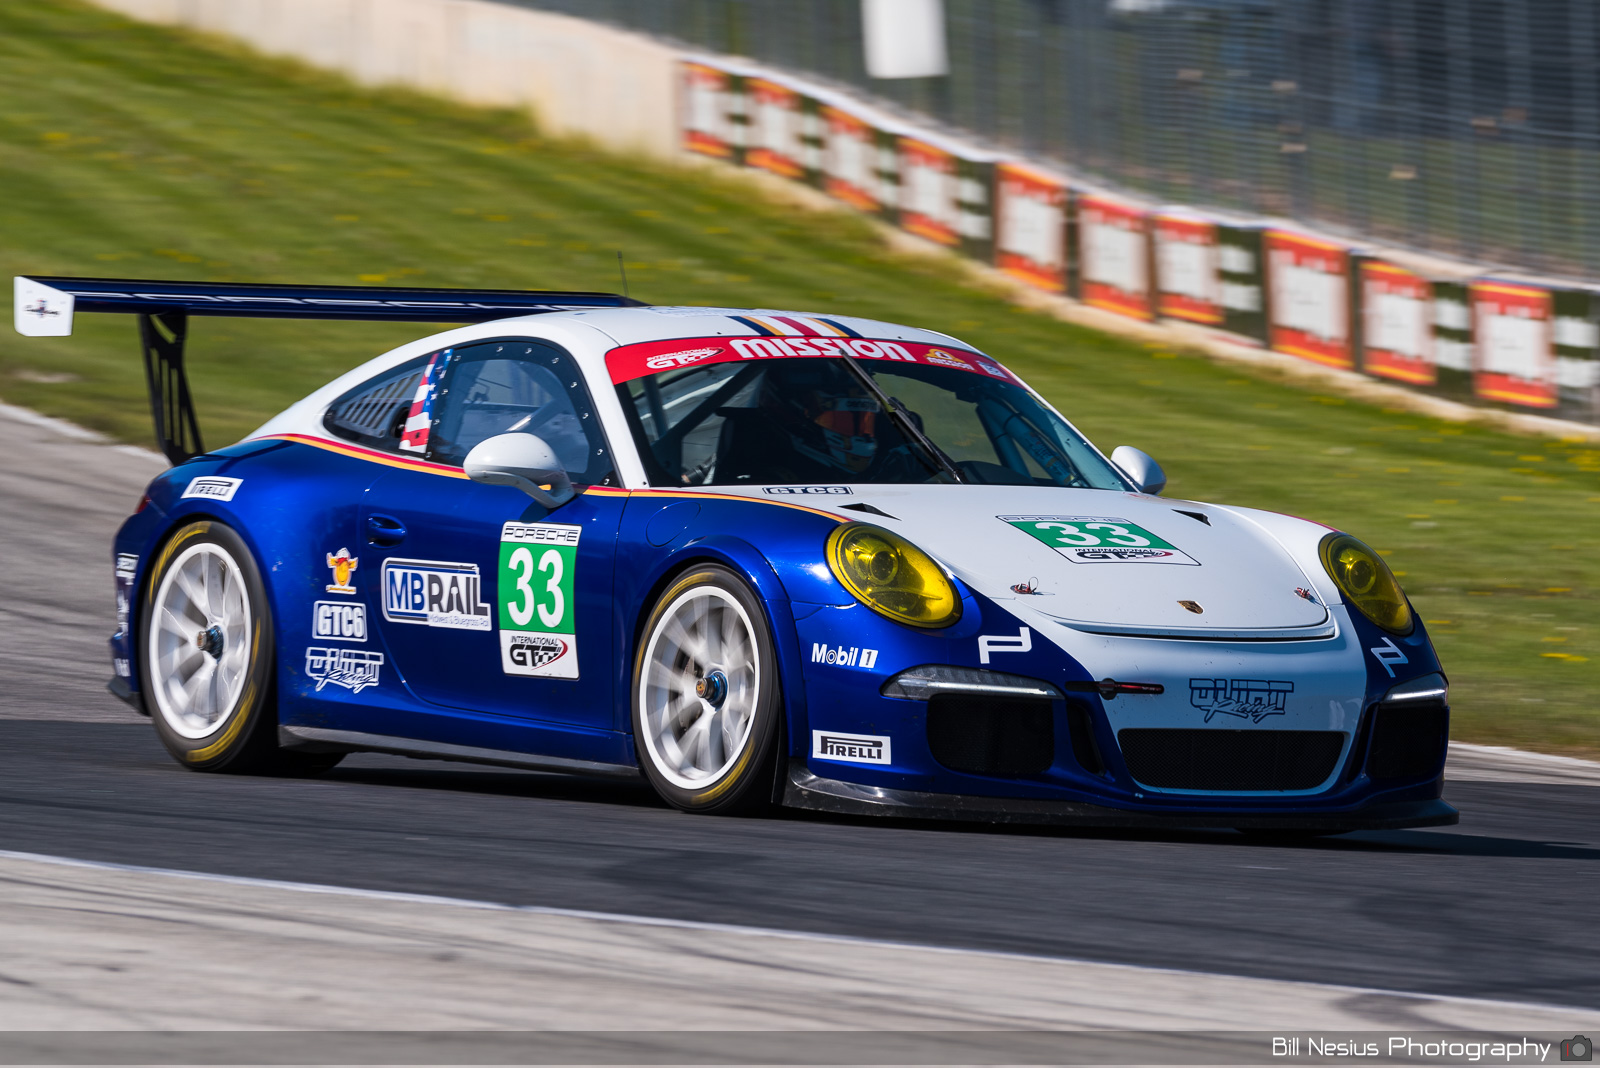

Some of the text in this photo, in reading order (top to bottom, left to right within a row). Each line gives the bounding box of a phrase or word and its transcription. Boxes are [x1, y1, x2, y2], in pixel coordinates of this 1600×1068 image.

[504, 527, 578, 542] PORSCHE
[1035, 522, 1151, 547] 33
[507, 547, 565, 628] 33
[317, 604, 365, 638] GTC6
[510, 635, 559, 646] INTERNATIONAL
[811, 642, 859, 667] Mobil
[1199, 699, 1286, 725] Racing
[820, 735, 884, 760] PIRELLI
